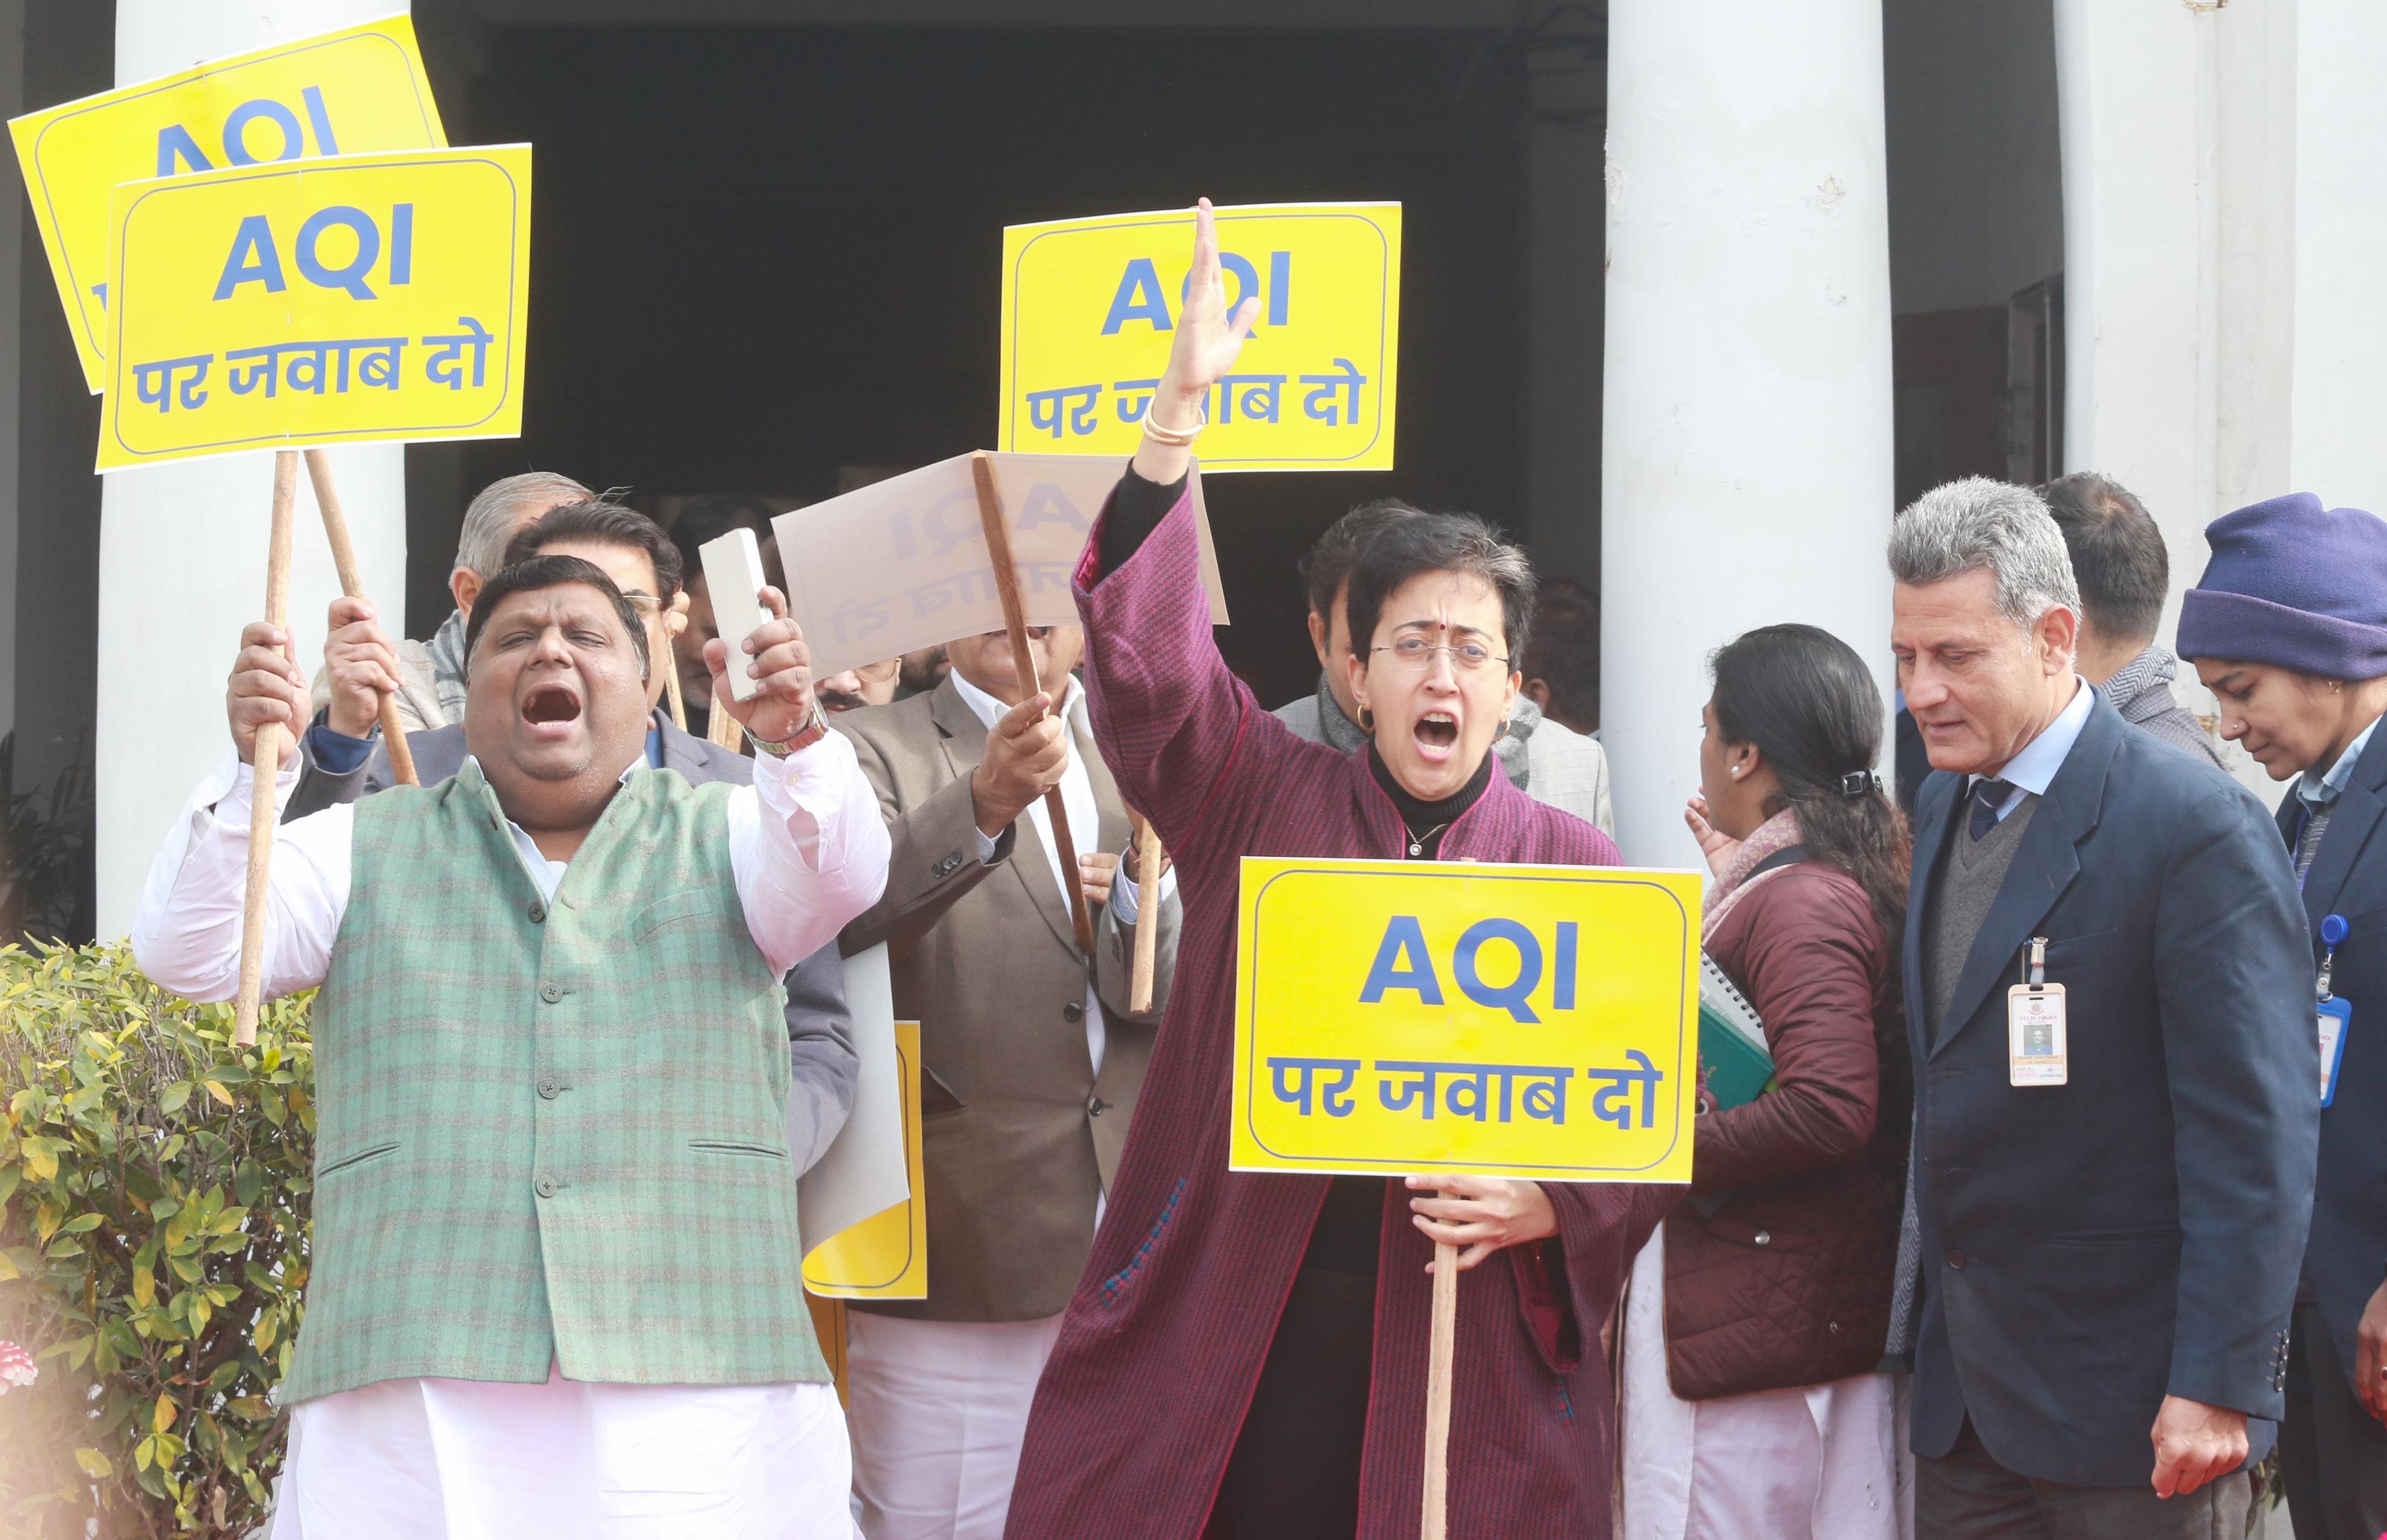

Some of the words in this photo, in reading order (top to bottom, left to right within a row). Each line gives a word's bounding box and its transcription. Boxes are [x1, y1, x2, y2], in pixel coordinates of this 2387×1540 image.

[212, 203, 413, 301] AQI
[132, 354, 214, 413] पर
[225, 337, 408, 398] जवाब
[422, 316, 494, 390] दो
[1026, 384, 1102, 438] पर
[1113, 374, 1287, 424] जाब
[1300, 358, 1366, 426] दो
[1358, 915, 1578, 1024] AQI
[1267, 1056, 1361, 1117] पर
[1375, 1060, 1574, 1125] जवाब
[1588, 1048, 1663, 1130] दो
